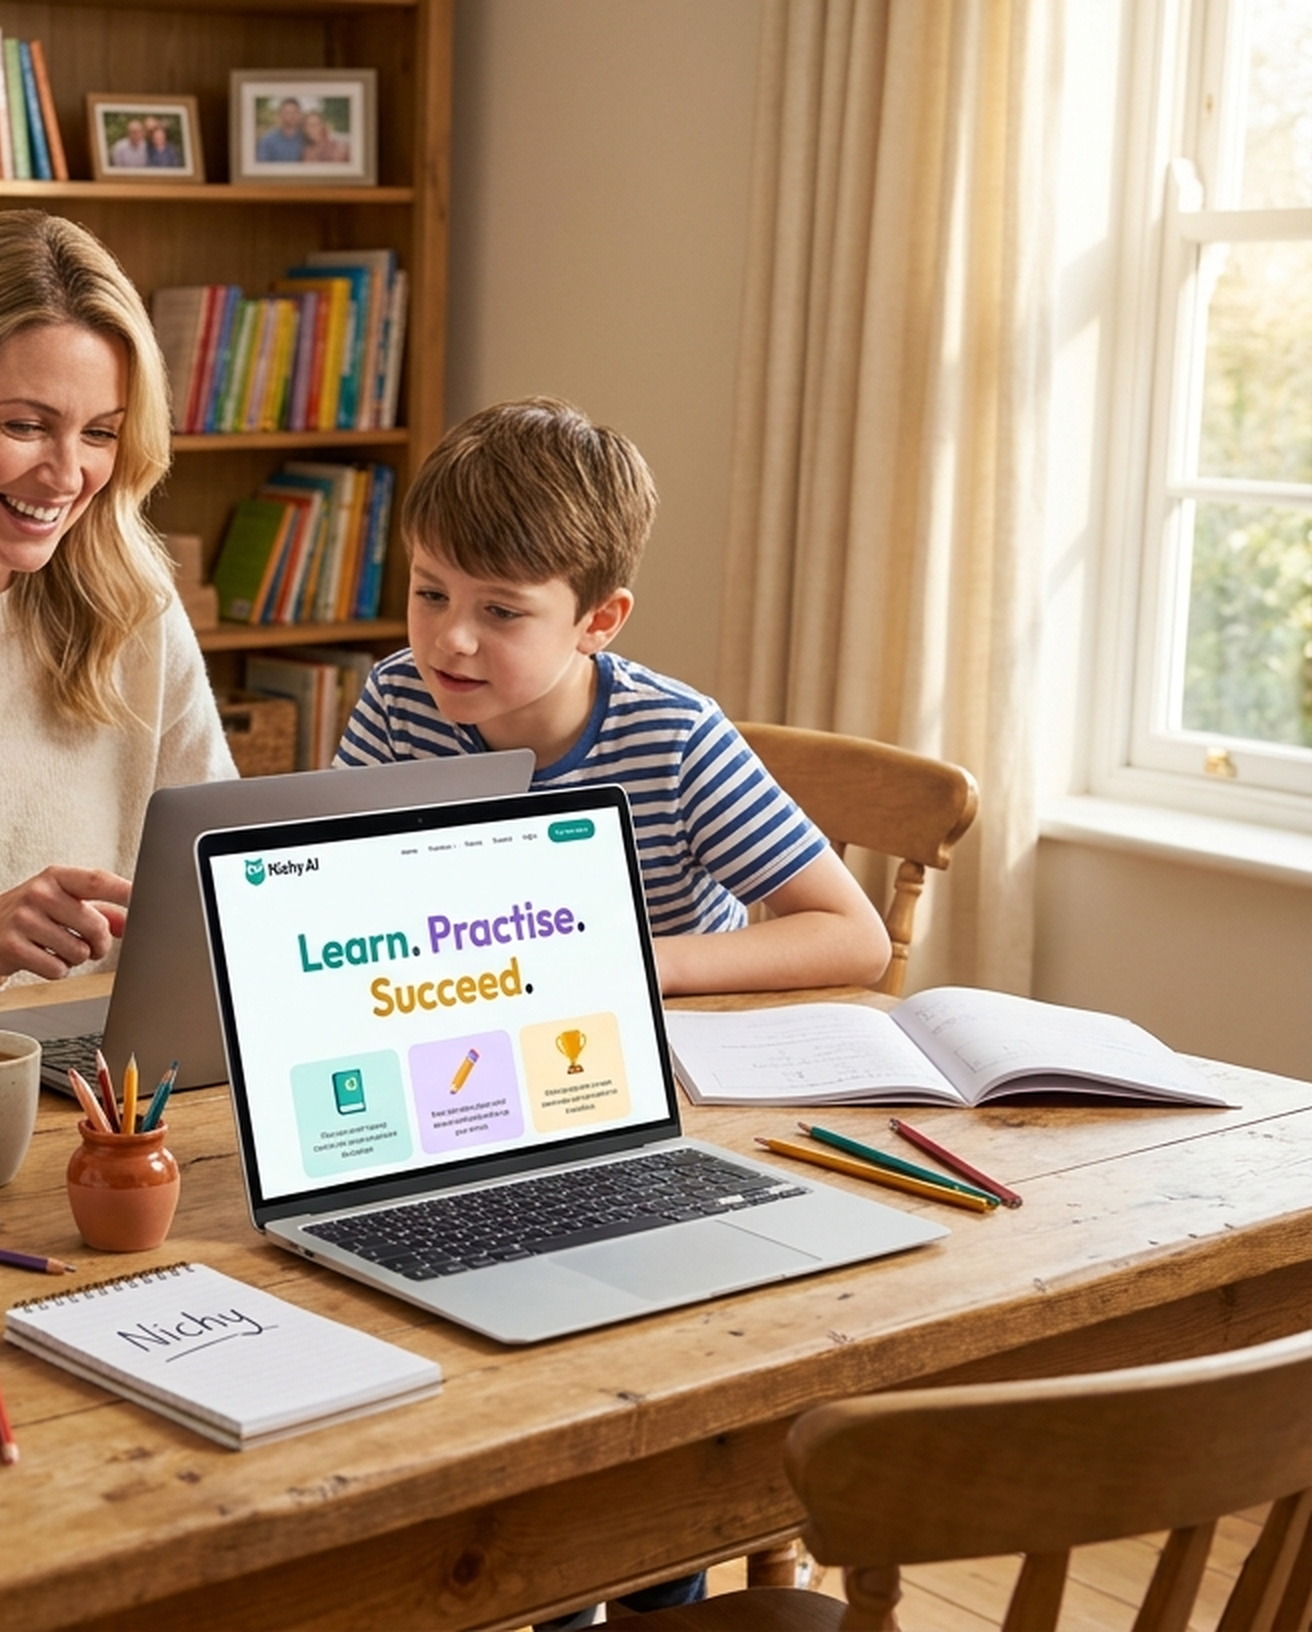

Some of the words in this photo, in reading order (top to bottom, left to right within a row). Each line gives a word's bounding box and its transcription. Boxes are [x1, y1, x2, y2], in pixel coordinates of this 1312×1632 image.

[298, 932, 421, 972] Learn.
[427, 901, 586, 954] Practise.
[370, 956, 534, 1018] Succeed.
[116, 1306, 264, 1353] Nichy
